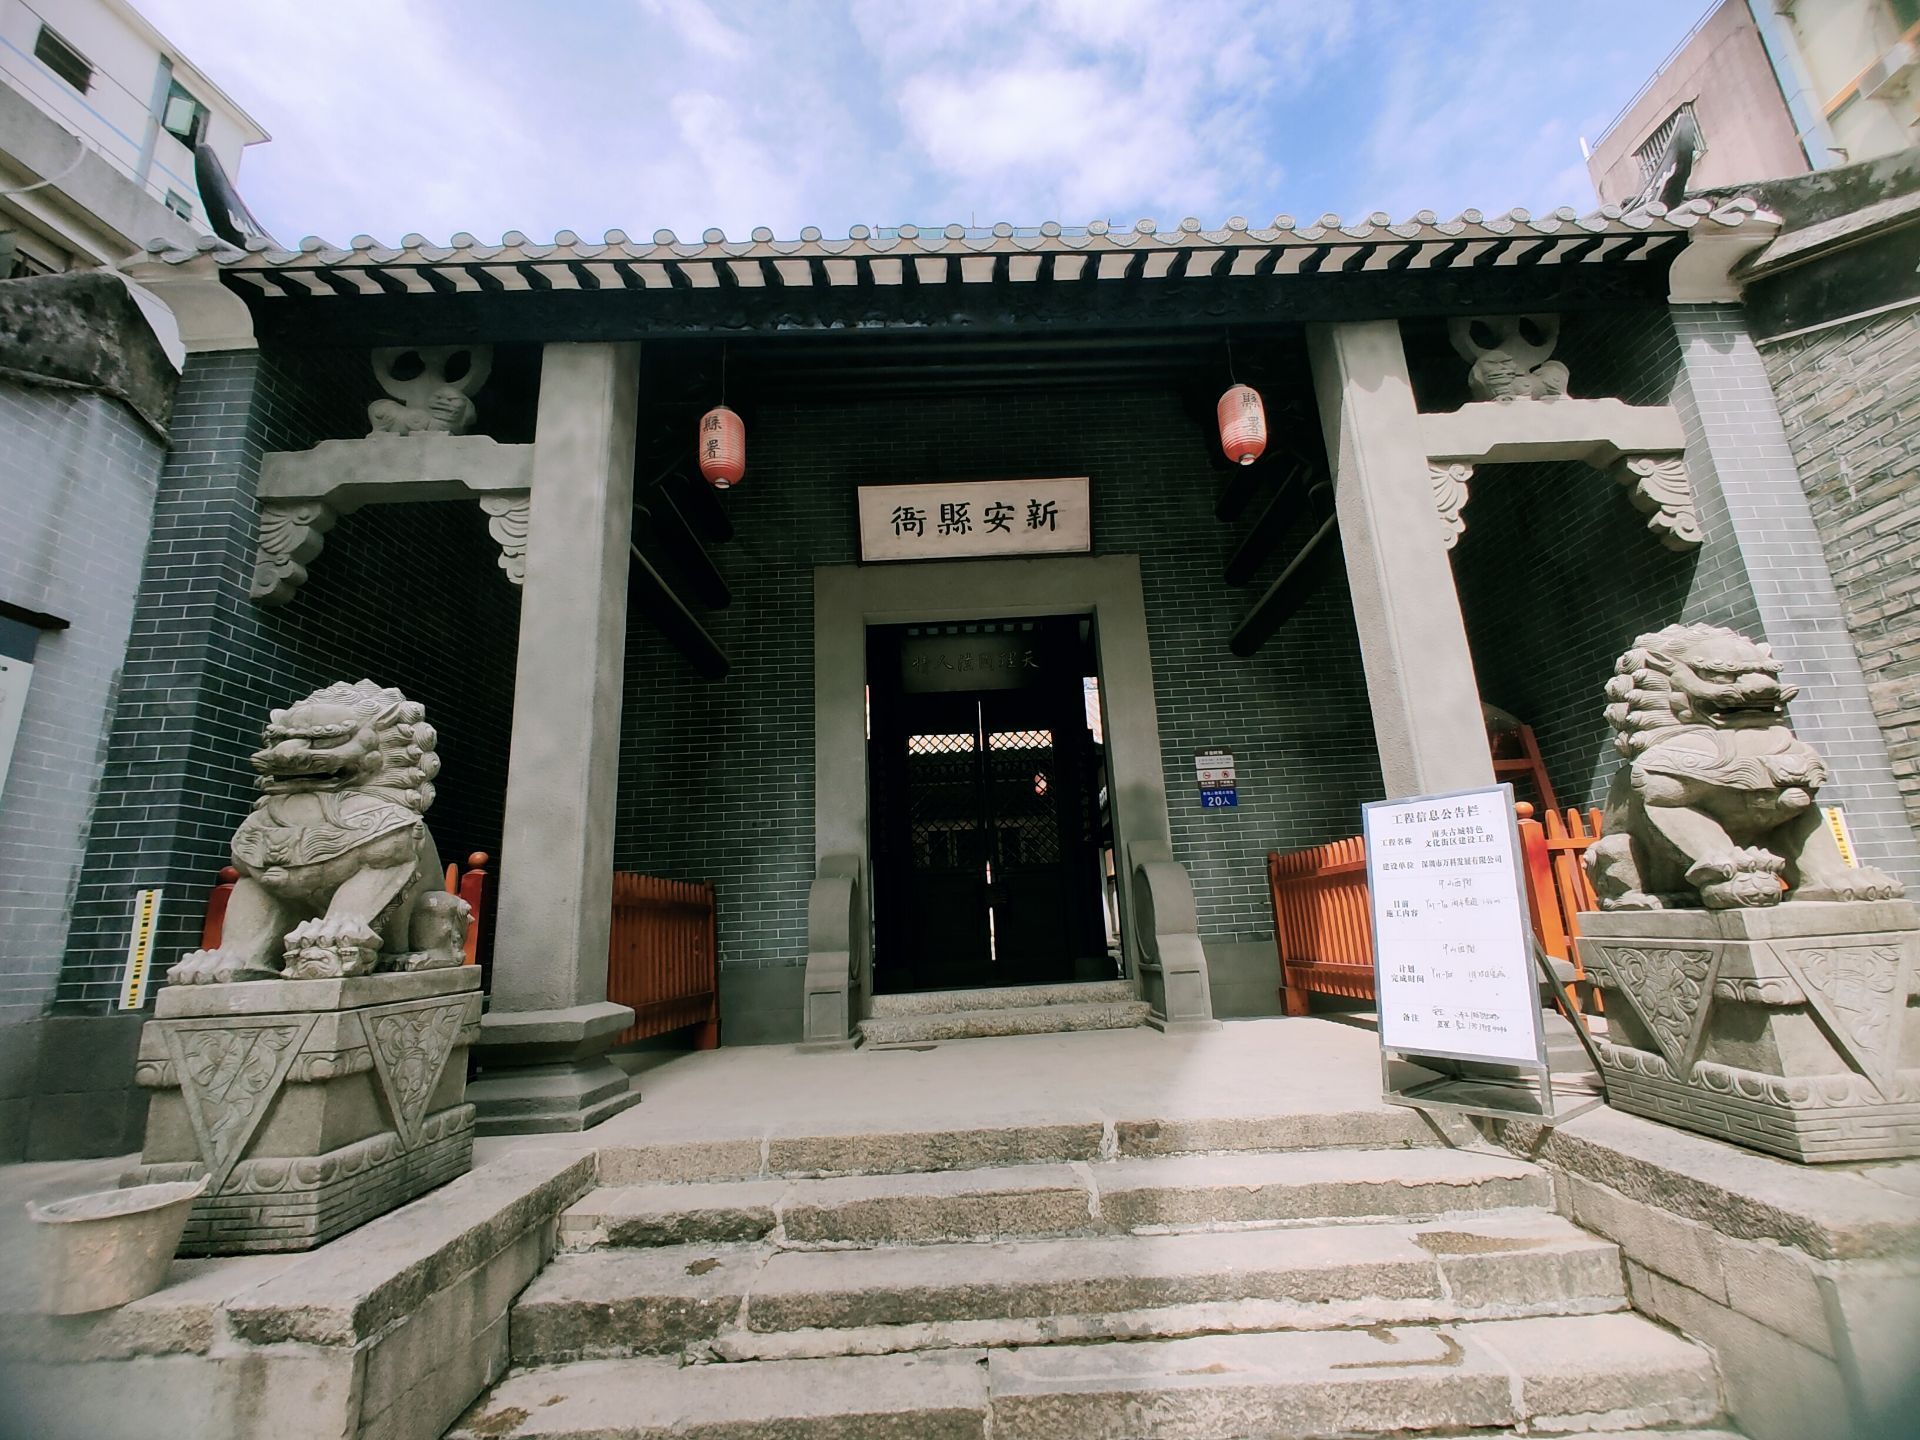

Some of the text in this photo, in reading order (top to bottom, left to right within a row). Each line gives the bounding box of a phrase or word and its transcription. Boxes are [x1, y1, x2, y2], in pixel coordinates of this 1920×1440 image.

[890, 499, 1058, 537] 新安縣衙
[1207, 796, 1231, 807] 20人
[1392, 804, 1480, 824] 工程信息公告栏
[1431, 825, 1484, 838] 南头古城特色
[1381, 836, 1413, 847] 工程名称
[1424, 834, 1495, 848] 文化街区建设工程
[1382, 861, 1415, 871] 建设单位
[1421, 855, 1502, 869] 深圳市万科发展有限公司
[1393, 900, 1409, 908] 目前
[1386, 909, 1418, 918] 施工内容
[1399, 964, 1415, 973] 计划
[1391, 974, 1425, 983] 完成时间
[1403, 1012, 1420, 1022] 备注
